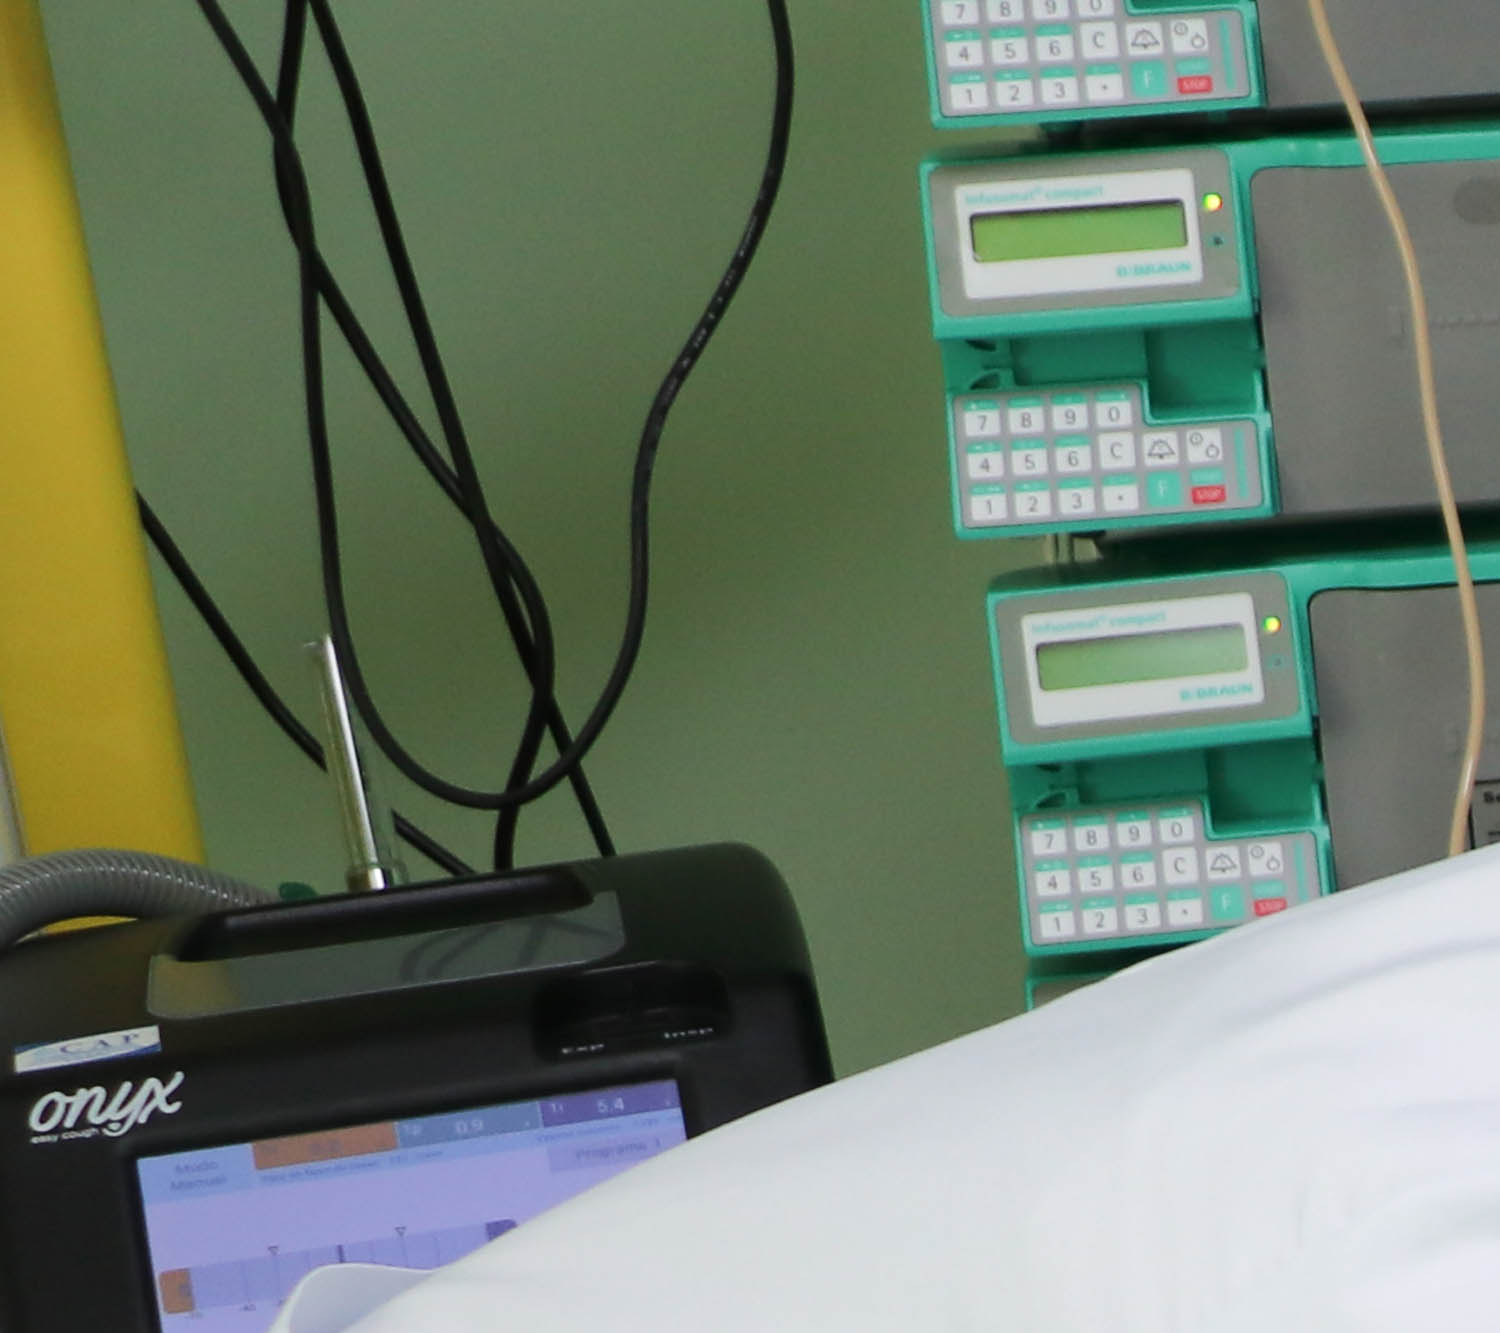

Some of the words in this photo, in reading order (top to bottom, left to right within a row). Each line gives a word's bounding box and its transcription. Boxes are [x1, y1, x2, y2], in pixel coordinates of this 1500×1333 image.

[959, 45, 969, 61] 4
[1005, 43, 1016, 59] 5
[1050, 40, 1060, 57] 6
[1093, 31, 1105, 49] C
[977, 414, 987, 431] 7
[1021, 411, 1032, 428] 8
[1064, 408, 1076, 425] 9
[1108, 405, 1120, 423] 0
[980, 457, 990, 473] 4
[1024, 454, 1035, 470] 5
[1067, 450, 1079, 467] 6
[1110, 441, 1123, 460] C
[985, 499, 992, 515] 1
[1028, 496, 1039, 513] 2
[1072, 492, 1083, 509] 3
[1044, 833, 1054, 849] 7
[1086, 830, 1097, 846] 8
[1128, 825, 1140, 843] 9
[1171, 821, 1183, 839] 0
[1047, 874, 1058, 891] 4
[1090, 871, 1101, 887] 5
[1132, 866, 1143, 883] 6
[1174, 856, 1186, 874] C
[1054, 916, 1061, 932] 1
[1095, 912, 1105, 928] 2
[1137, 908, 1148, 925] 3
[29, 1070, 185, 1137] onyx
[597, 1097, 625, 1114] 5.4
